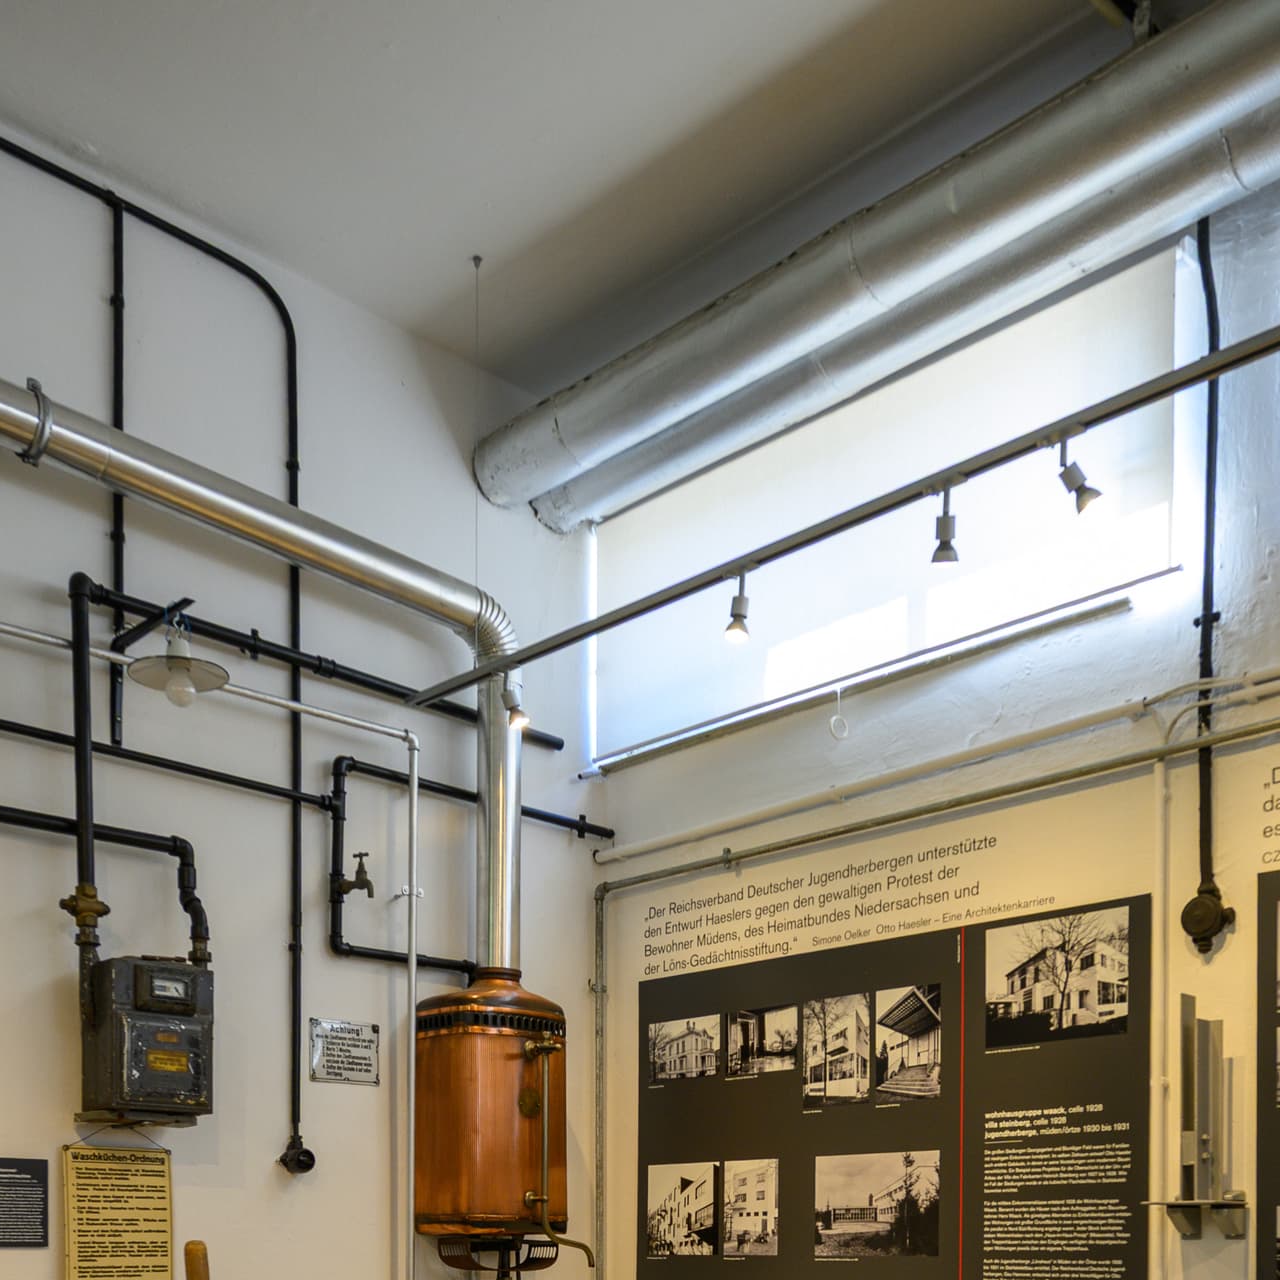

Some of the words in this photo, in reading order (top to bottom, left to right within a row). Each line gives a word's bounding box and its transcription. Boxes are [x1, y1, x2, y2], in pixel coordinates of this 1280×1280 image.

[644, 924, 662, 942] den
[664, 914, 703, 935] Entwurf
[706, 908, 752, 927] Haeslers
[754, 901, 790, 920] gegen
[793, 895, 815, 910] den
[818, 882, 882, 908] gewaltigen
[886, 869, 933, 893] Protest
[937, 865, 960, 880] der
[668, 887, 744, 916] Reichsverband
[747, 877, 805, 899] Deutscher
[807, 854, 914, 888] Jugendherbergen
[917, 835, 997, 867] unterstützte
[644, 939, 694, 960] Bewohner
[696, 931, 741, 948] Müdens,
[744, 925, 764, 938] des
[767, 907, 851, 934] Heimatbundes
[854, 890, 950, 918] Niedersachsen
[954, 880, 980, 900] und
[811, 932, 843, 948] Simone
[843, 928, 872, 942] Oelker
[875, 923, 896, 935] Otto
[898, 917, 932, 932] Haesler
[942, 912, 962, 924] Eine
[964, 896, 1056, 920] Architektenkarriere
[644, 962, 661, 976] der
[662, 937, 804, 973] Löns-Gedächtnisstiftung.“
[71, 1151, 166, 1166] Waschküchen-Ordnung
